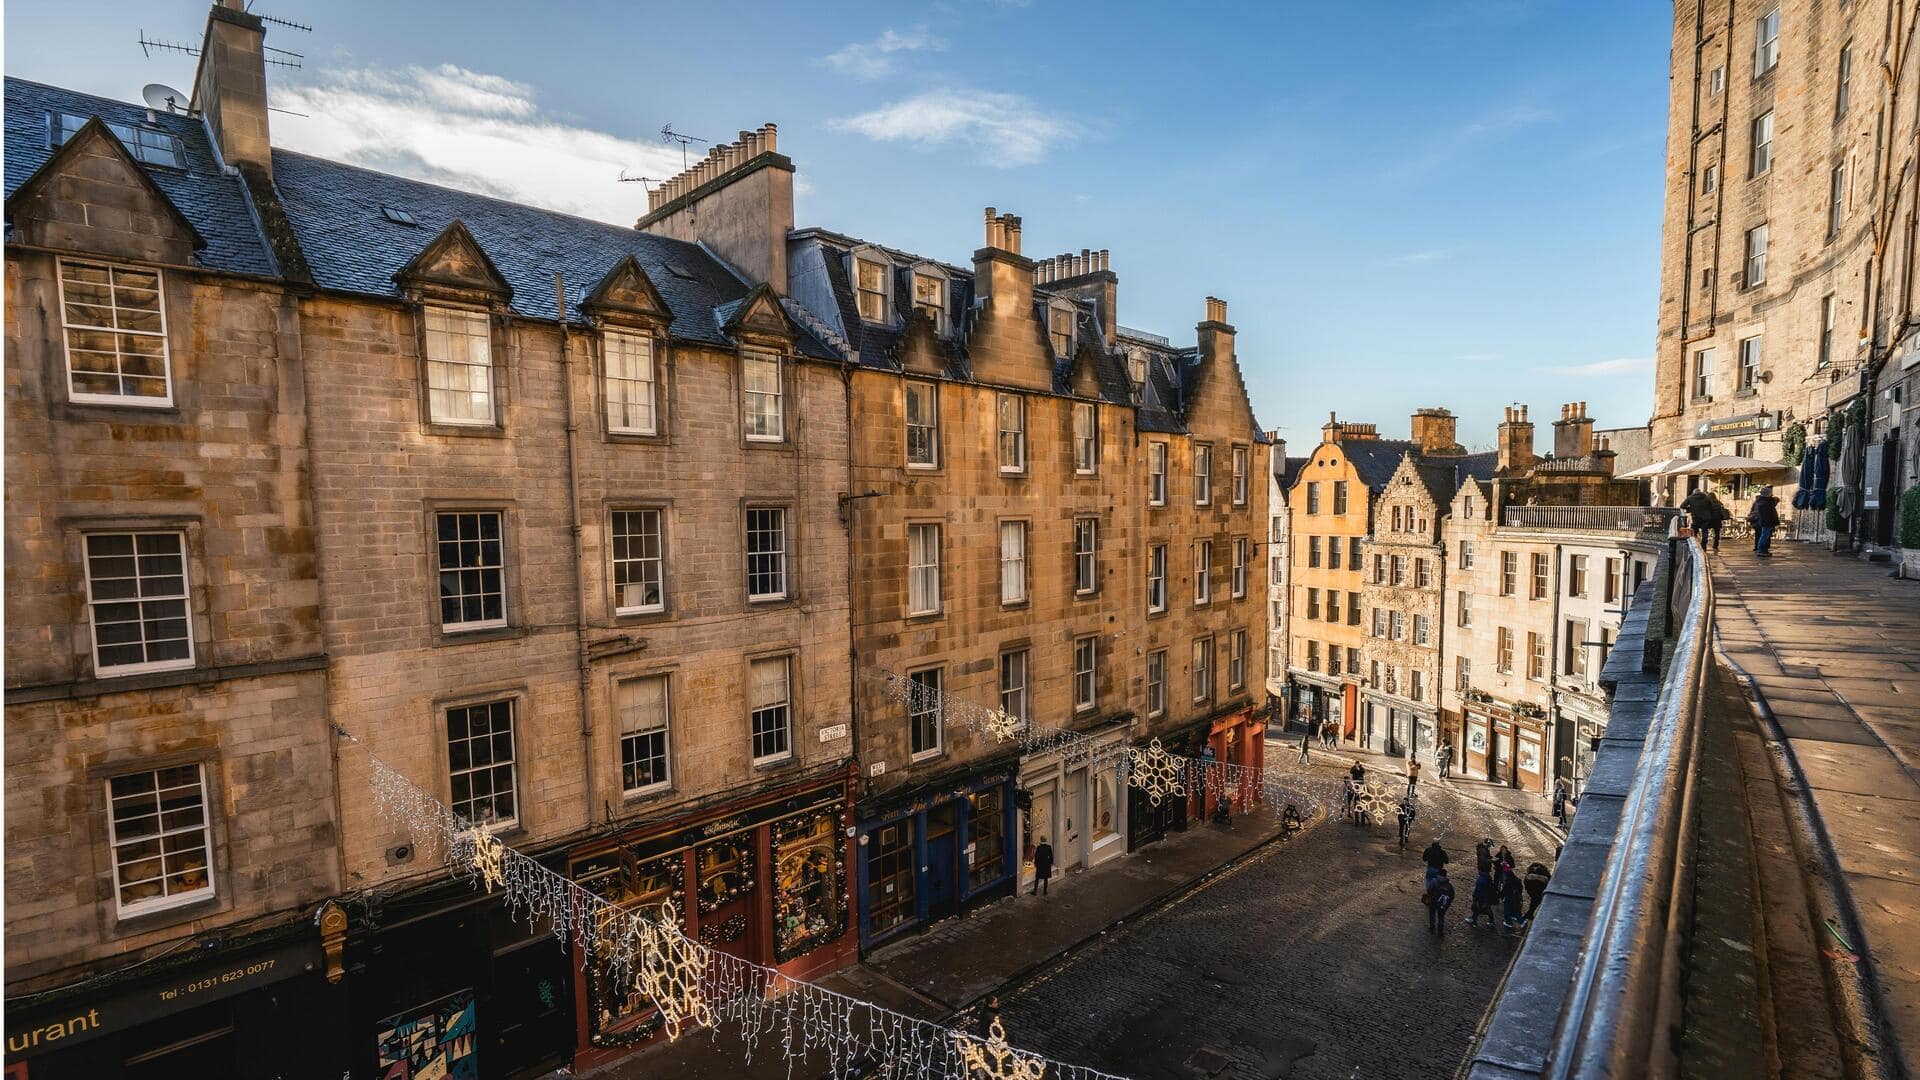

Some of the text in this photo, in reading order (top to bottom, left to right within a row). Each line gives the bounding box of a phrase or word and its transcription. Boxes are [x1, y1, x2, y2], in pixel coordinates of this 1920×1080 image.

[821, 725, 845, 735] VICTORIA
[824, 731, 844, 740] STREET
[160, 989, 177, 1001] Tel
[188, 977, 217, 993] 0131
[222, 969, 245, 983] 623
[247, 960, 276, 975] 0077
[5, 1008, 100, 1053] urant
